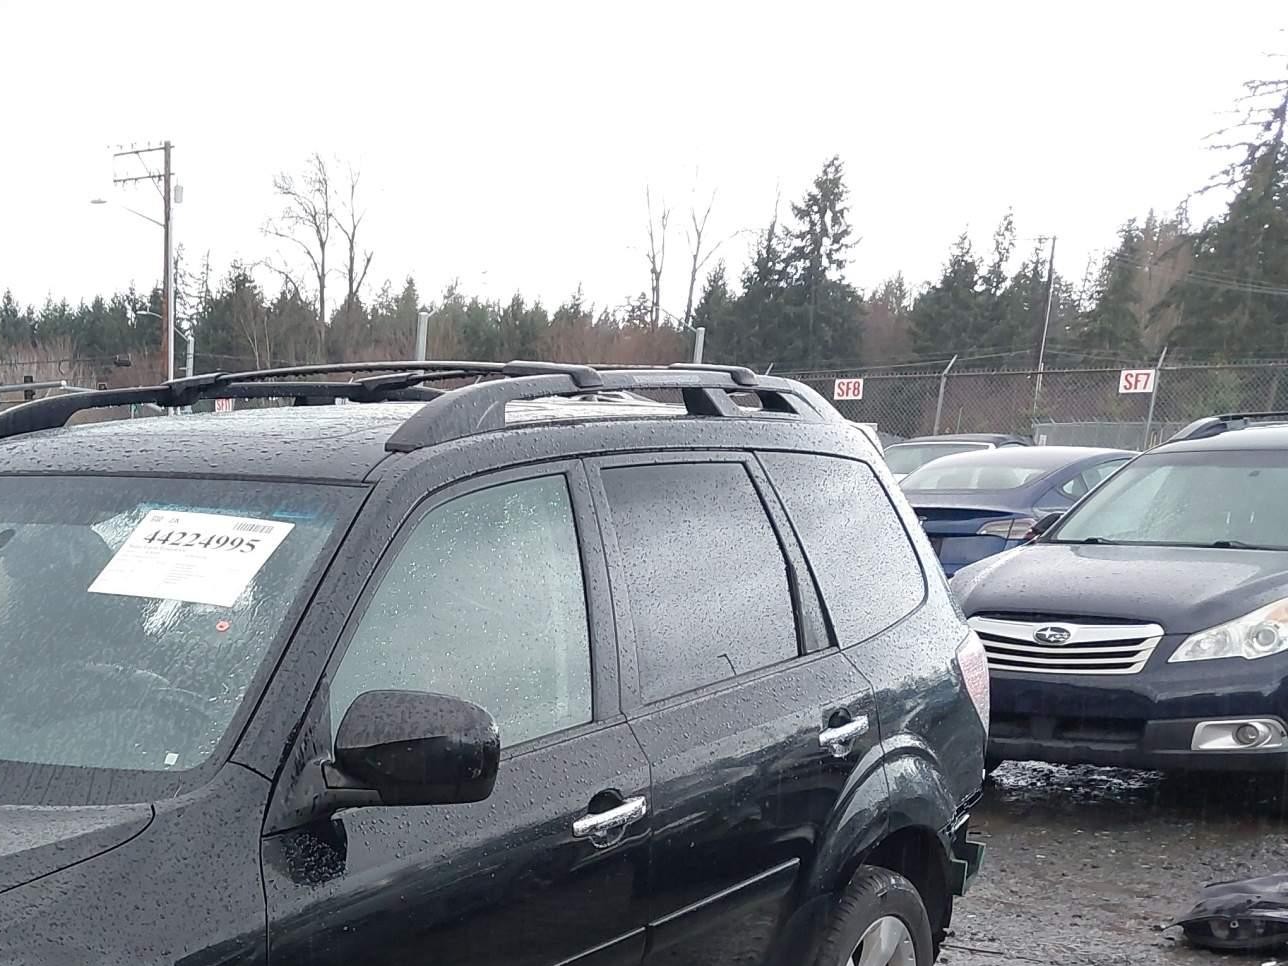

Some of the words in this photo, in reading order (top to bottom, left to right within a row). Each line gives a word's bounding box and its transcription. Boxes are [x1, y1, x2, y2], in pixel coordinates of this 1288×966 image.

[837, 381, 860, 397] SF8
[1123, 373, 1151, 390] SF7
[144, 530, 261, 553] 44224995
